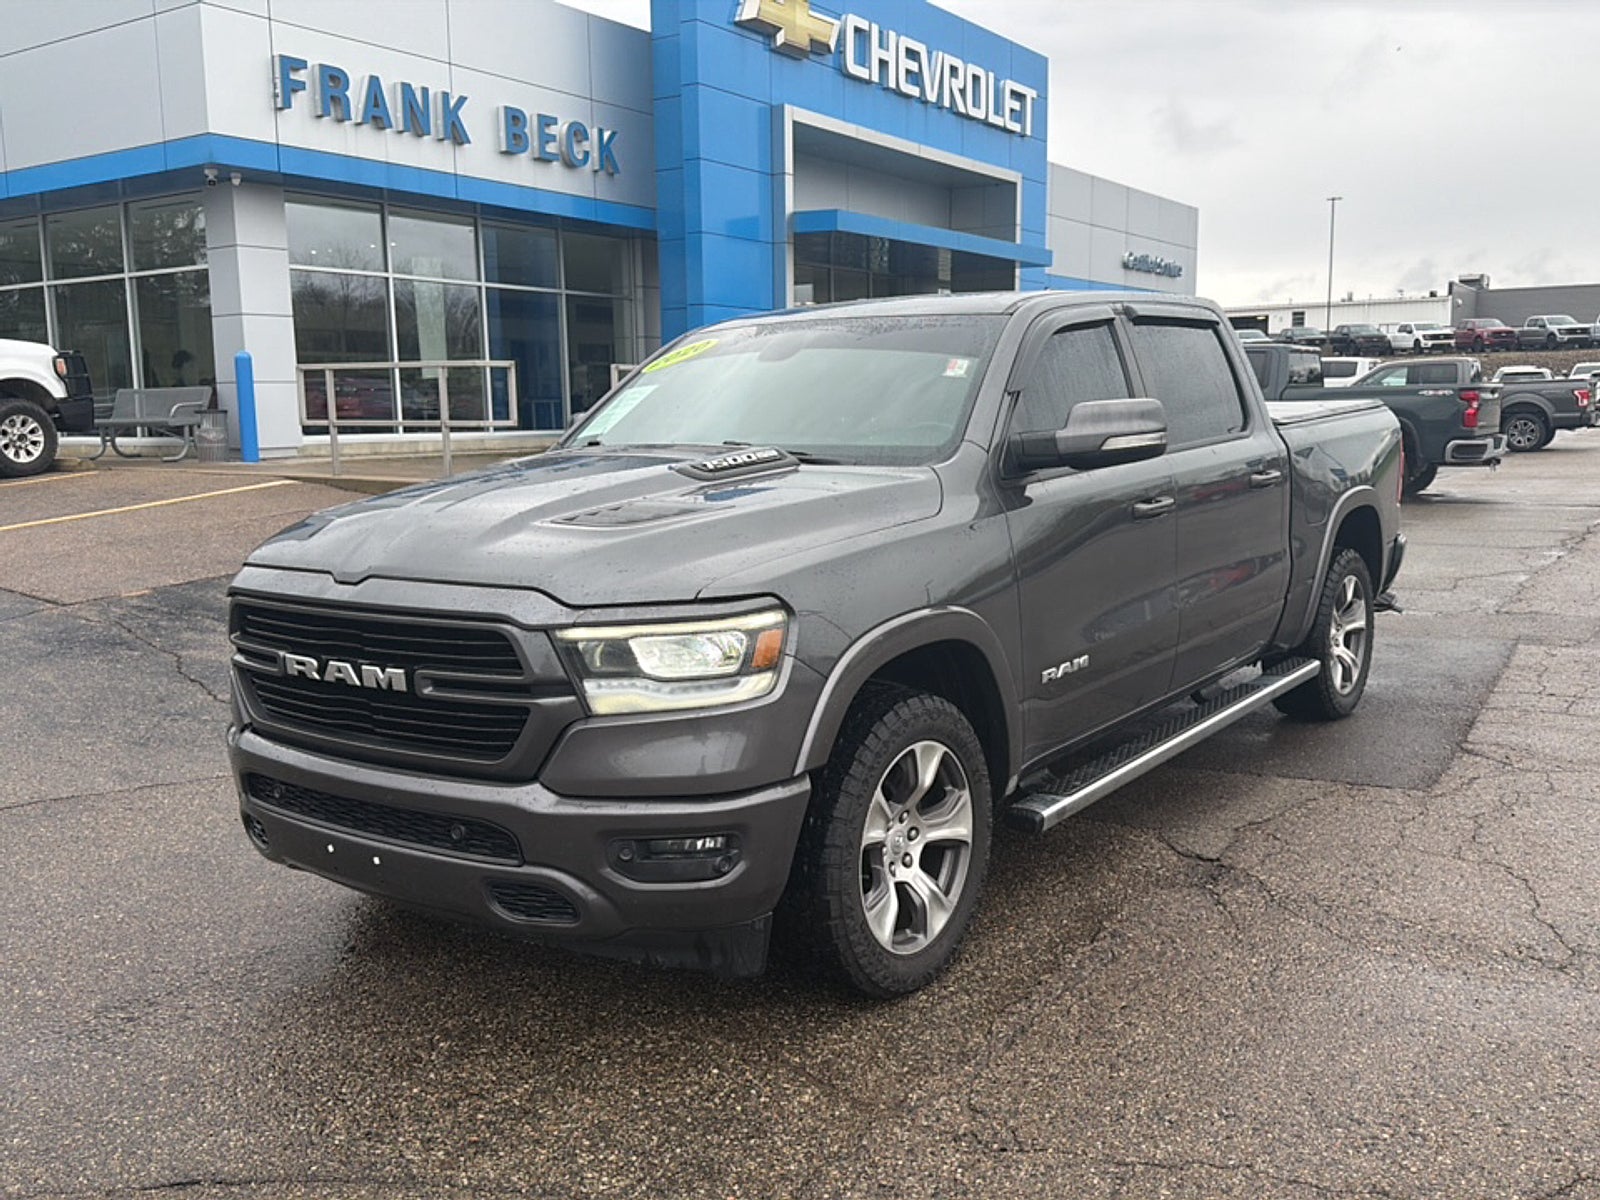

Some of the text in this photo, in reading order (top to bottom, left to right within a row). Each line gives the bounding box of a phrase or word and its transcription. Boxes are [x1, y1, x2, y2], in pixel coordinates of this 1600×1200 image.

[842, 13, 1038, 137] CHEVROLET
[276, 53, 621, 175] FRANK BECK
[701, 453, 758, 470] 1500
[284, 652, 408, 692] RAM
[1041, 654, 1089, 685] RAM
